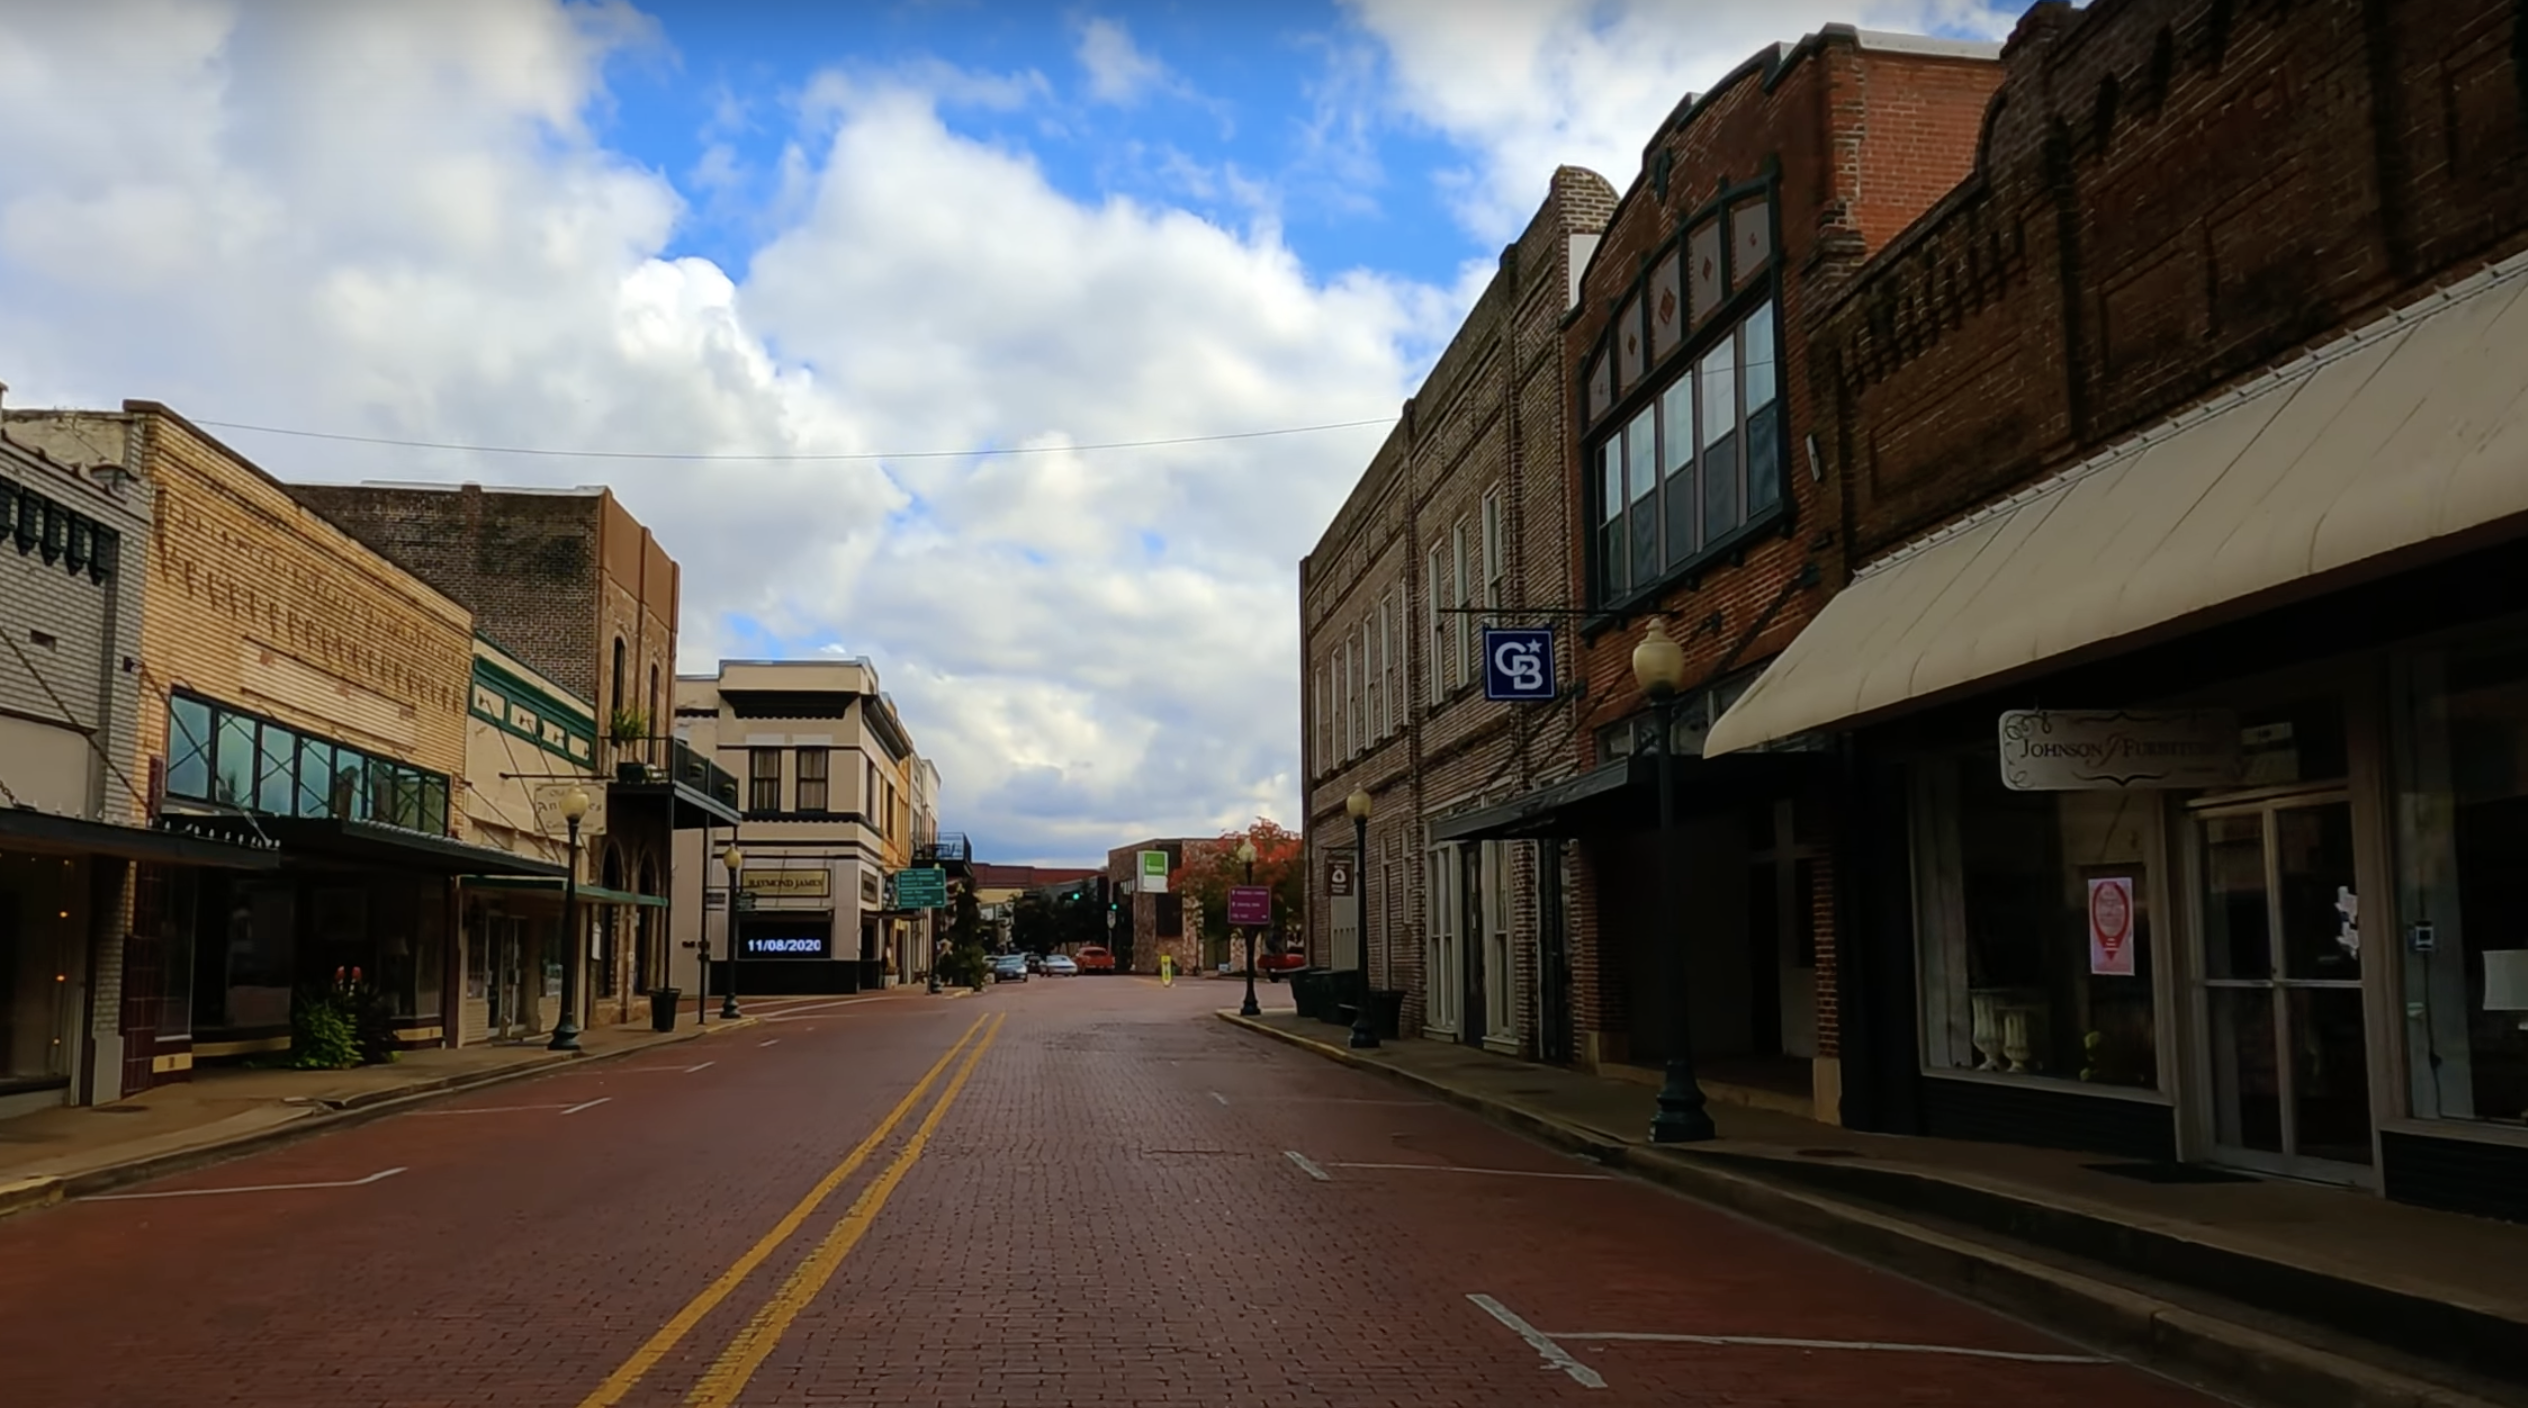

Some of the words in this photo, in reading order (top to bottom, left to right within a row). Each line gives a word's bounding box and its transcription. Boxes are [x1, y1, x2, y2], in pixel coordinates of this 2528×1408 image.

[1495, 641, 1543, 690] CB
[2020, 739, 2102, 758] JOHNSON
[2123, 738, 2215, 757] FURNIT
[537, 801, 602, 813] Anes
[749, 879, 794, 888] RAYMOND
[794, 879, 823, 890] JAMES
[748, 939, 822, 952] 11/08/2020
